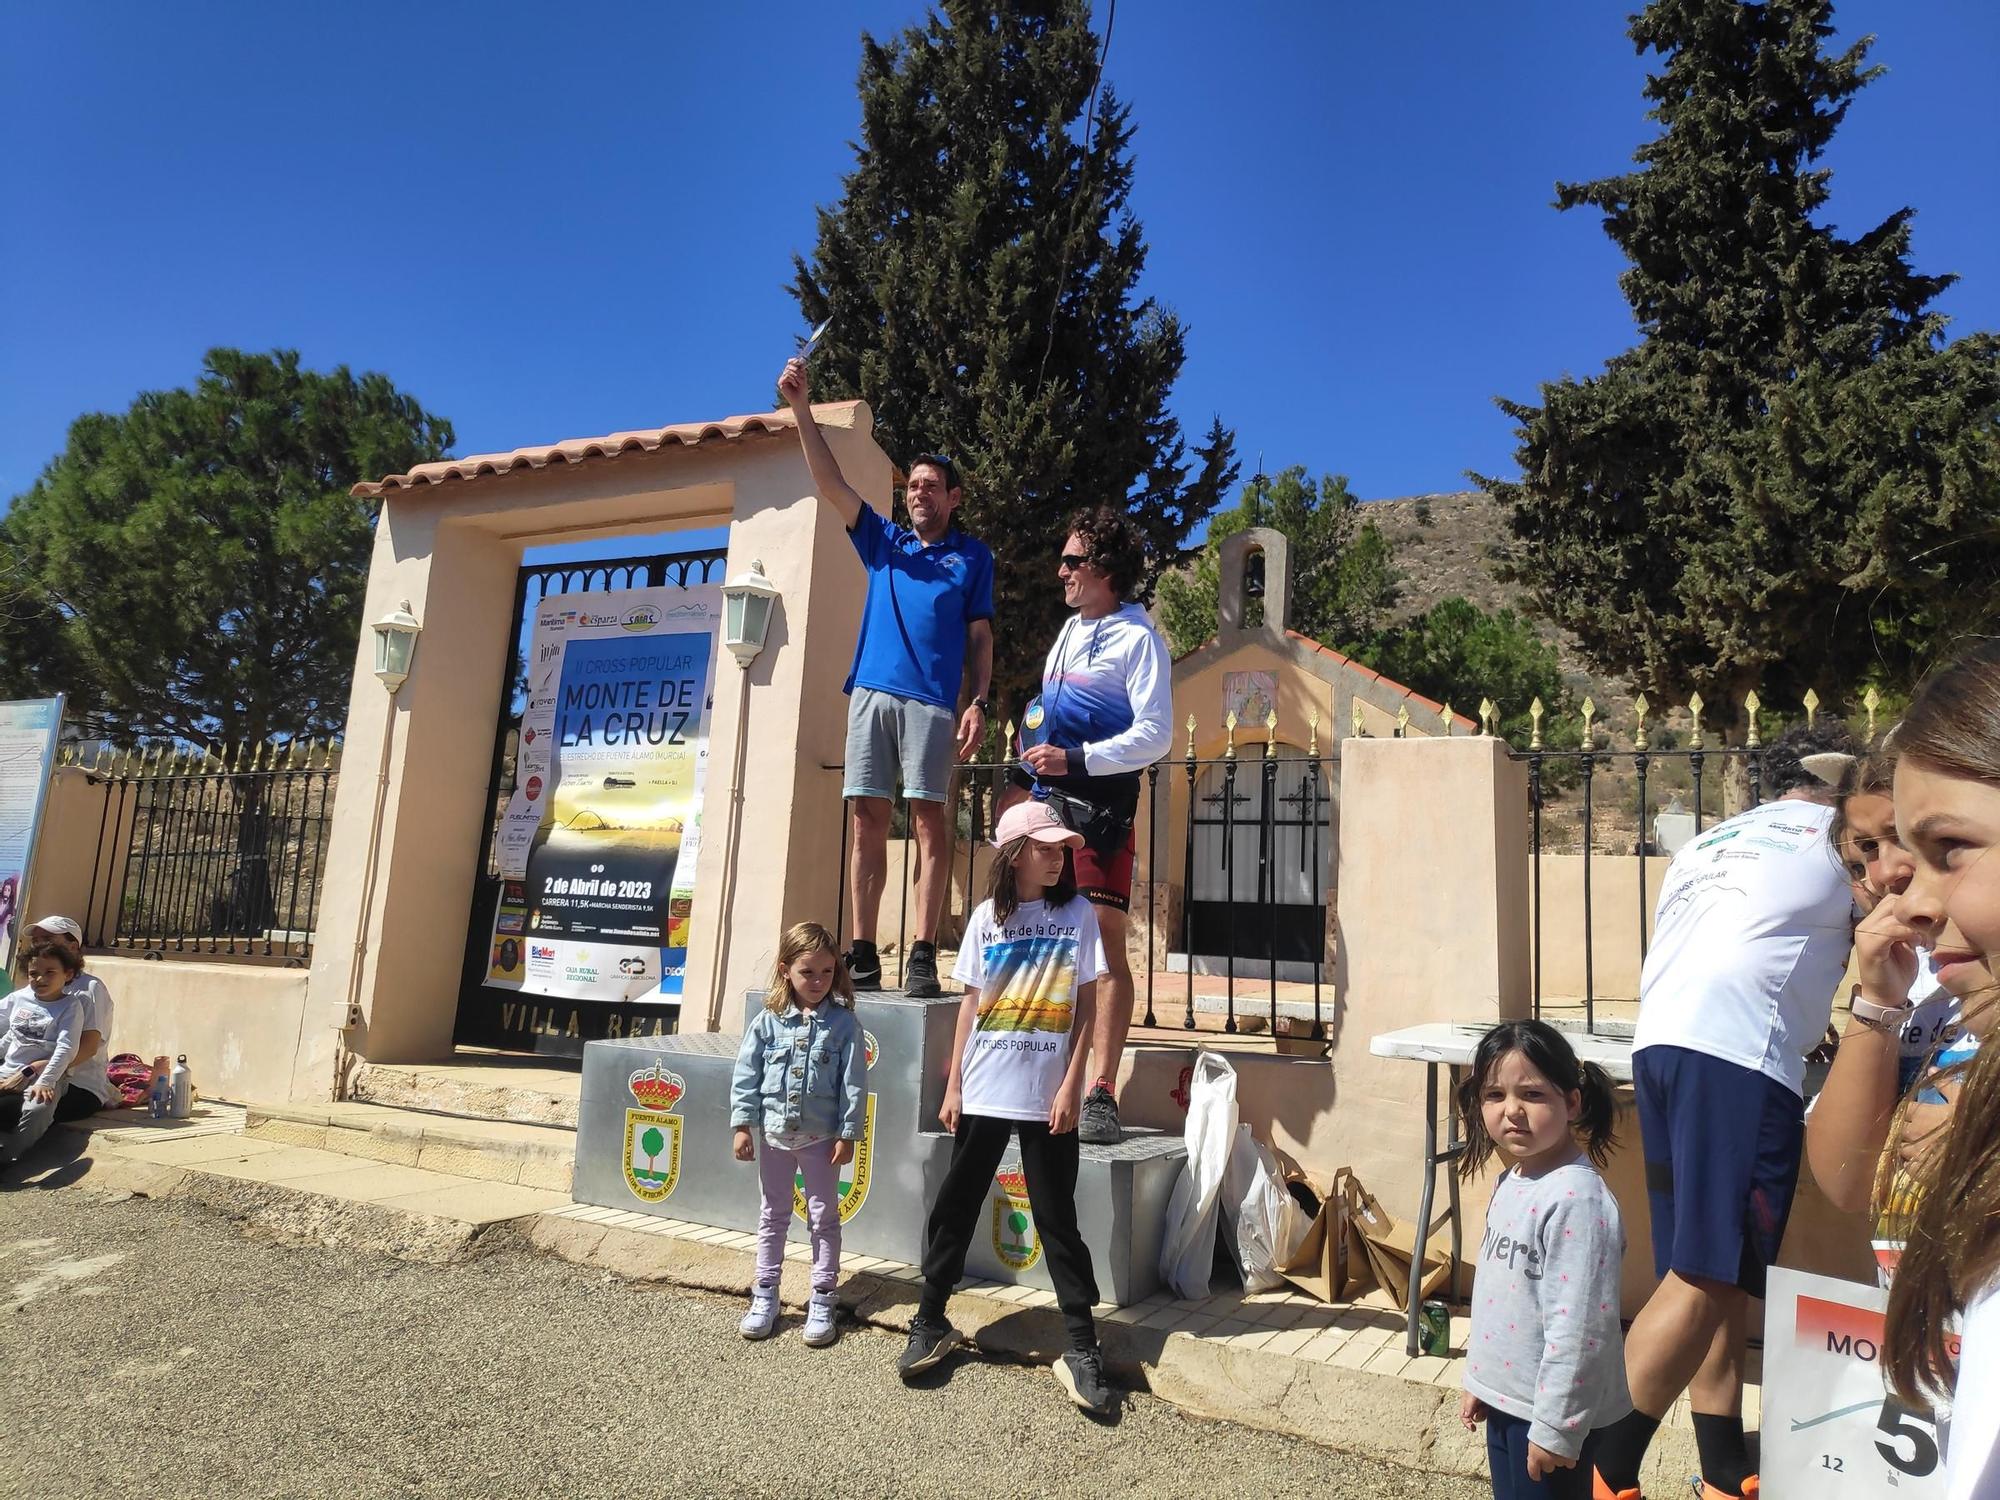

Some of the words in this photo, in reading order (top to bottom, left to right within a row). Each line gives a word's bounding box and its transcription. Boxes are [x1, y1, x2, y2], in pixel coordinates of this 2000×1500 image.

[585, 658, 626, 674] CROSS
[629, 655, 693, 673] POPULAR
[564, 681, 650, 712] MONTE
[658, 679, 696, 708] DE
[560, 712, 593, 747] LA
[603, 711, 691, 746] CRUZ
[606, 752, 630, 760] FUENTE
[544, 877, 553, 893] 2
[553, 878, 568, 894] de
[569, 879, 599, 896] Abril
[600, 880, 616, 897] de
[617, 881, 652, 899] 2023
[541, 897, 569, 907] CARRERA
[1018, 924, 1032, 937] de
[1036, 923, 1045, 936] la
[1048, 923, 1075, 937] Cruz
[503, 1002, 580, 1039] VILLA
[1010, 1040, 1057, 1053] POPULAR
[631, 1113, 655, 1123] FUENTE
[671, 1142, 679, 1176] MURCIA
[857, 1137, 868, 1187] MURCIA
[845, 1188, 862, 1214] MUY
[1874, 1394, 1939, 1478] 5
[1821, 1454, 1844, 1473] 12
